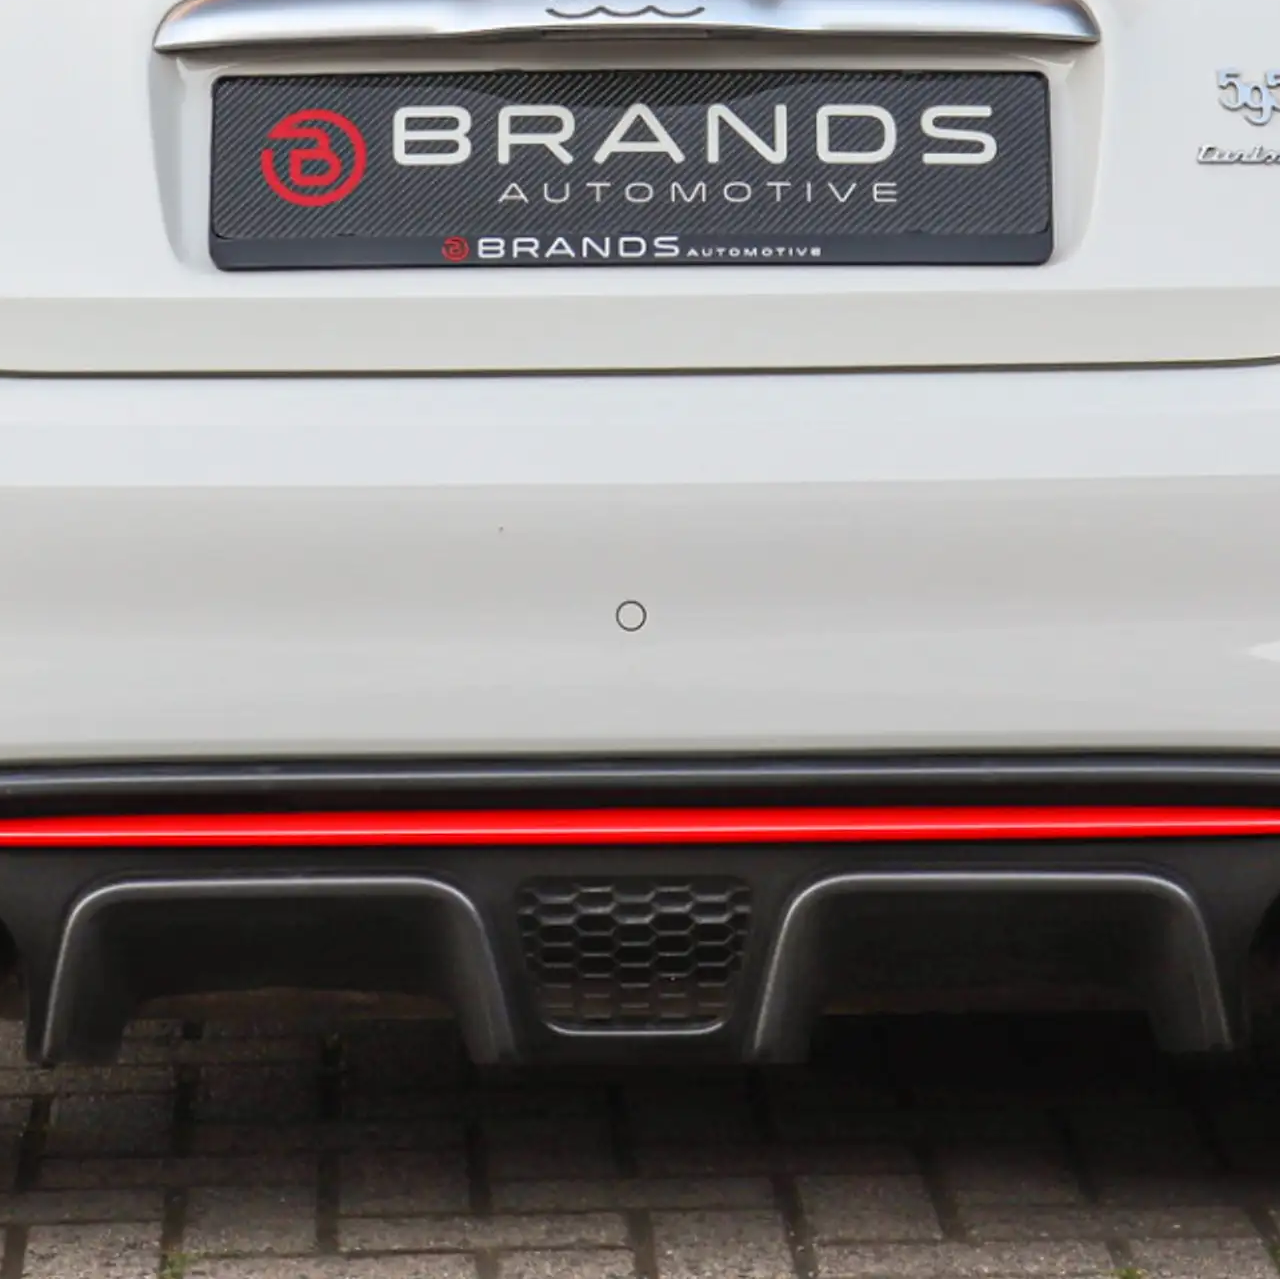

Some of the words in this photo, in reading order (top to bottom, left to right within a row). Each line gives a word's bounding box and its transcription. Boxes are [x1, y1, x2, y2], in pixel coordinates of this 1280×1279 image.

[393, 103, 997, 165] BRANDS
[498, 181, 898, 203] AUTOMOTIVE
[477, 235, 680, 258] BRANDS
[686, 246, 822, 258] AUTOMOTIVE
